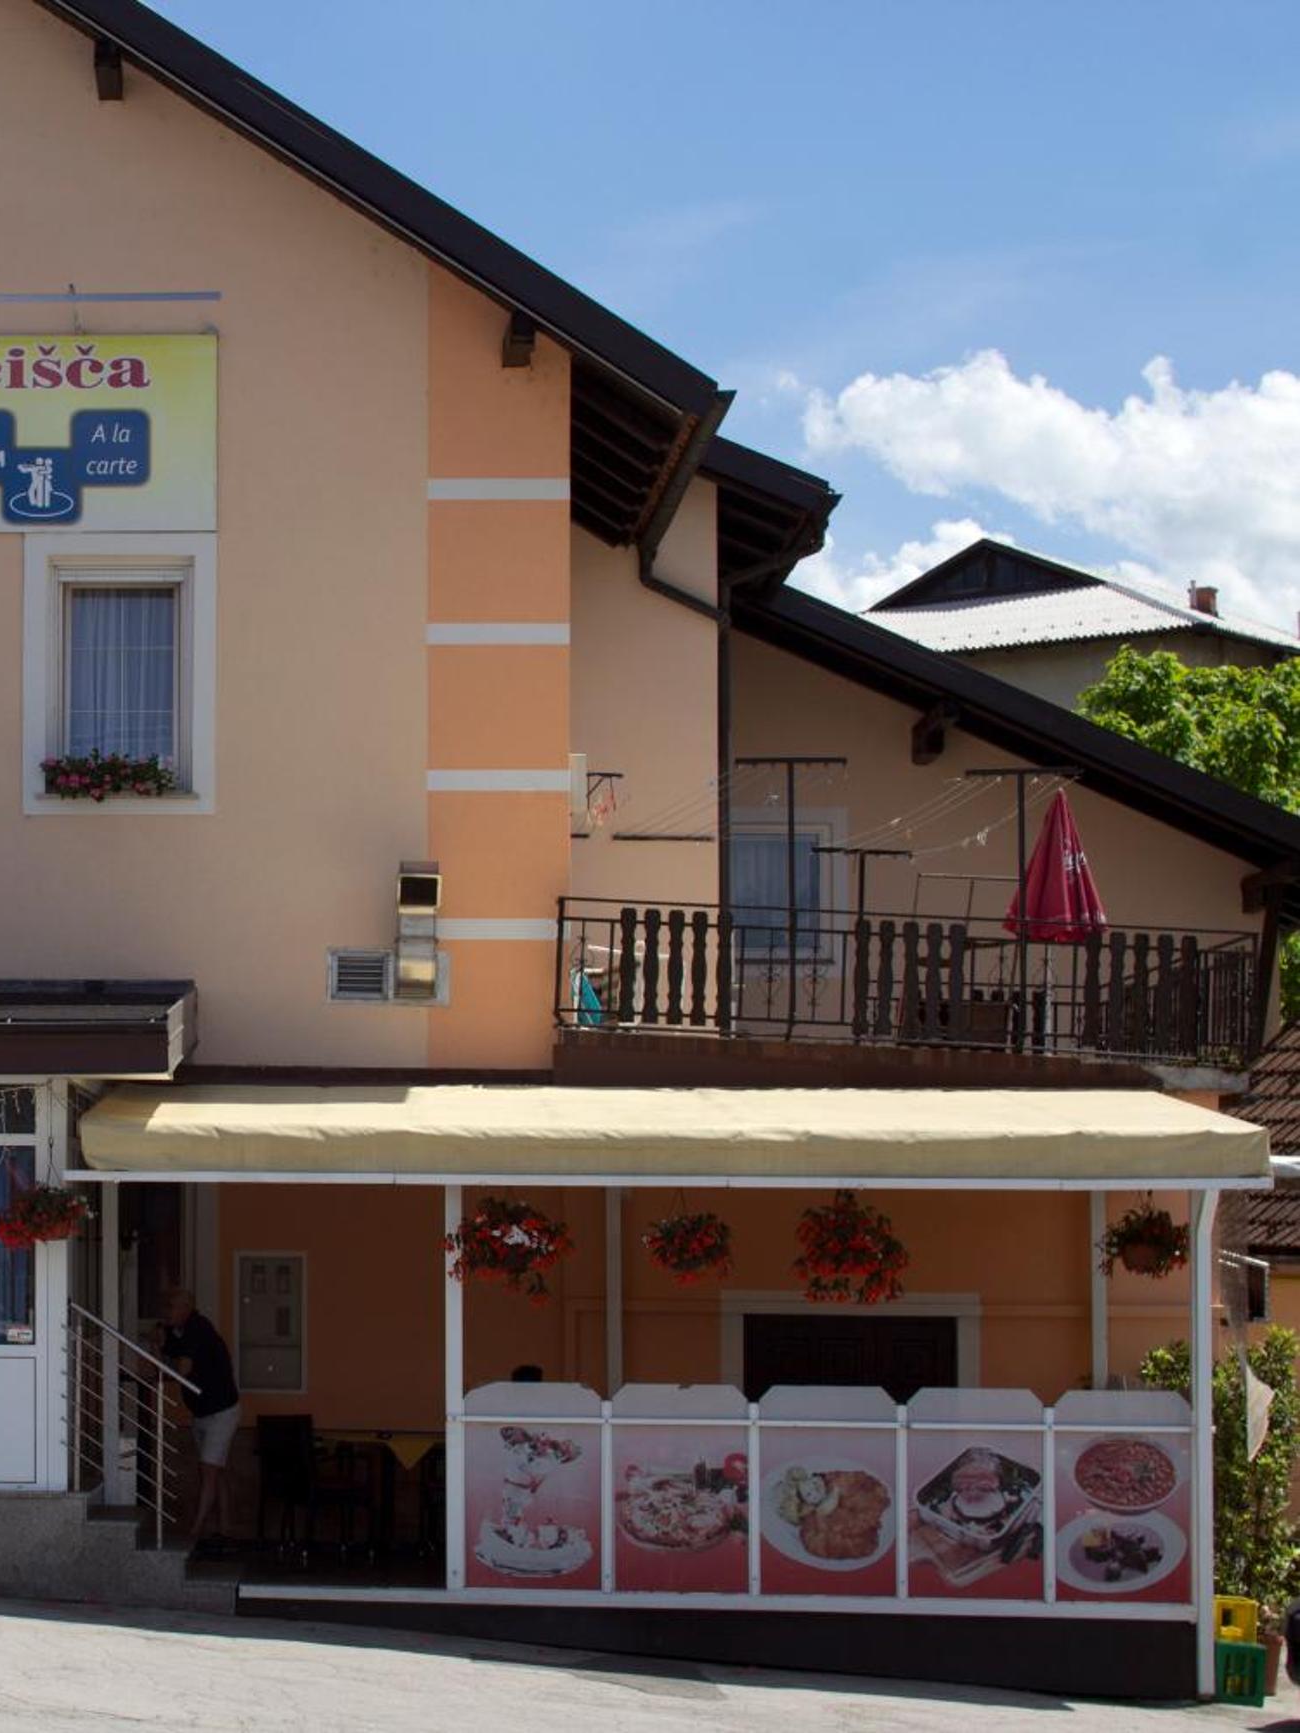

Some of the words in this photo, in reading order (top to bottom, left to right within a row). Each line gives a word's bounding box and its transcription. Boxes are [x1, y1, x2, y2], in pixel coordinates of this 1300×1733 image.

[91, 425, 105, 444] A
[112, 423, 131, 444] la
[85, 457, 139, 475] carte
